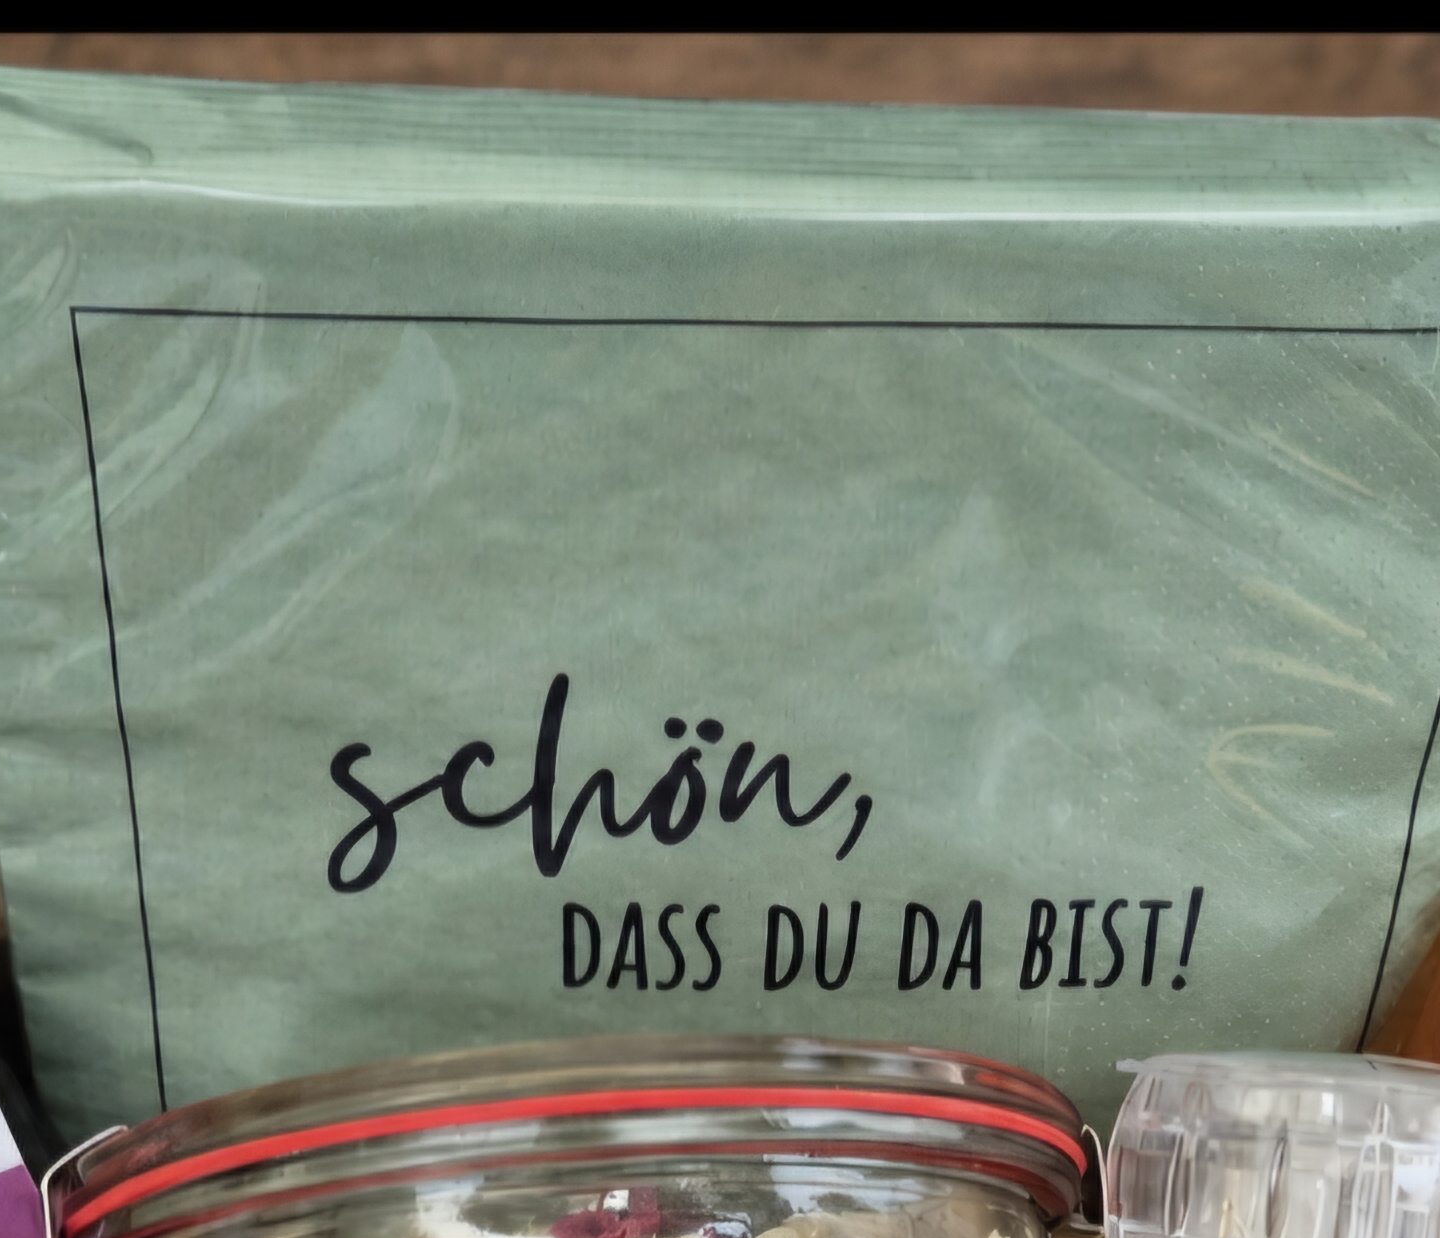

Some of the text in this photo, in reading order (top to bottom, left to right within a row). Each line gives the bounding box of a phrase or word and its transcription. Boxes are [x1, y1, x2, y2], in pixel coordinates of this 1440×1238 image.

[328, 673, 872, 893] schön,
[563, 886, 1203, 991] DASS DU DA BIST!
